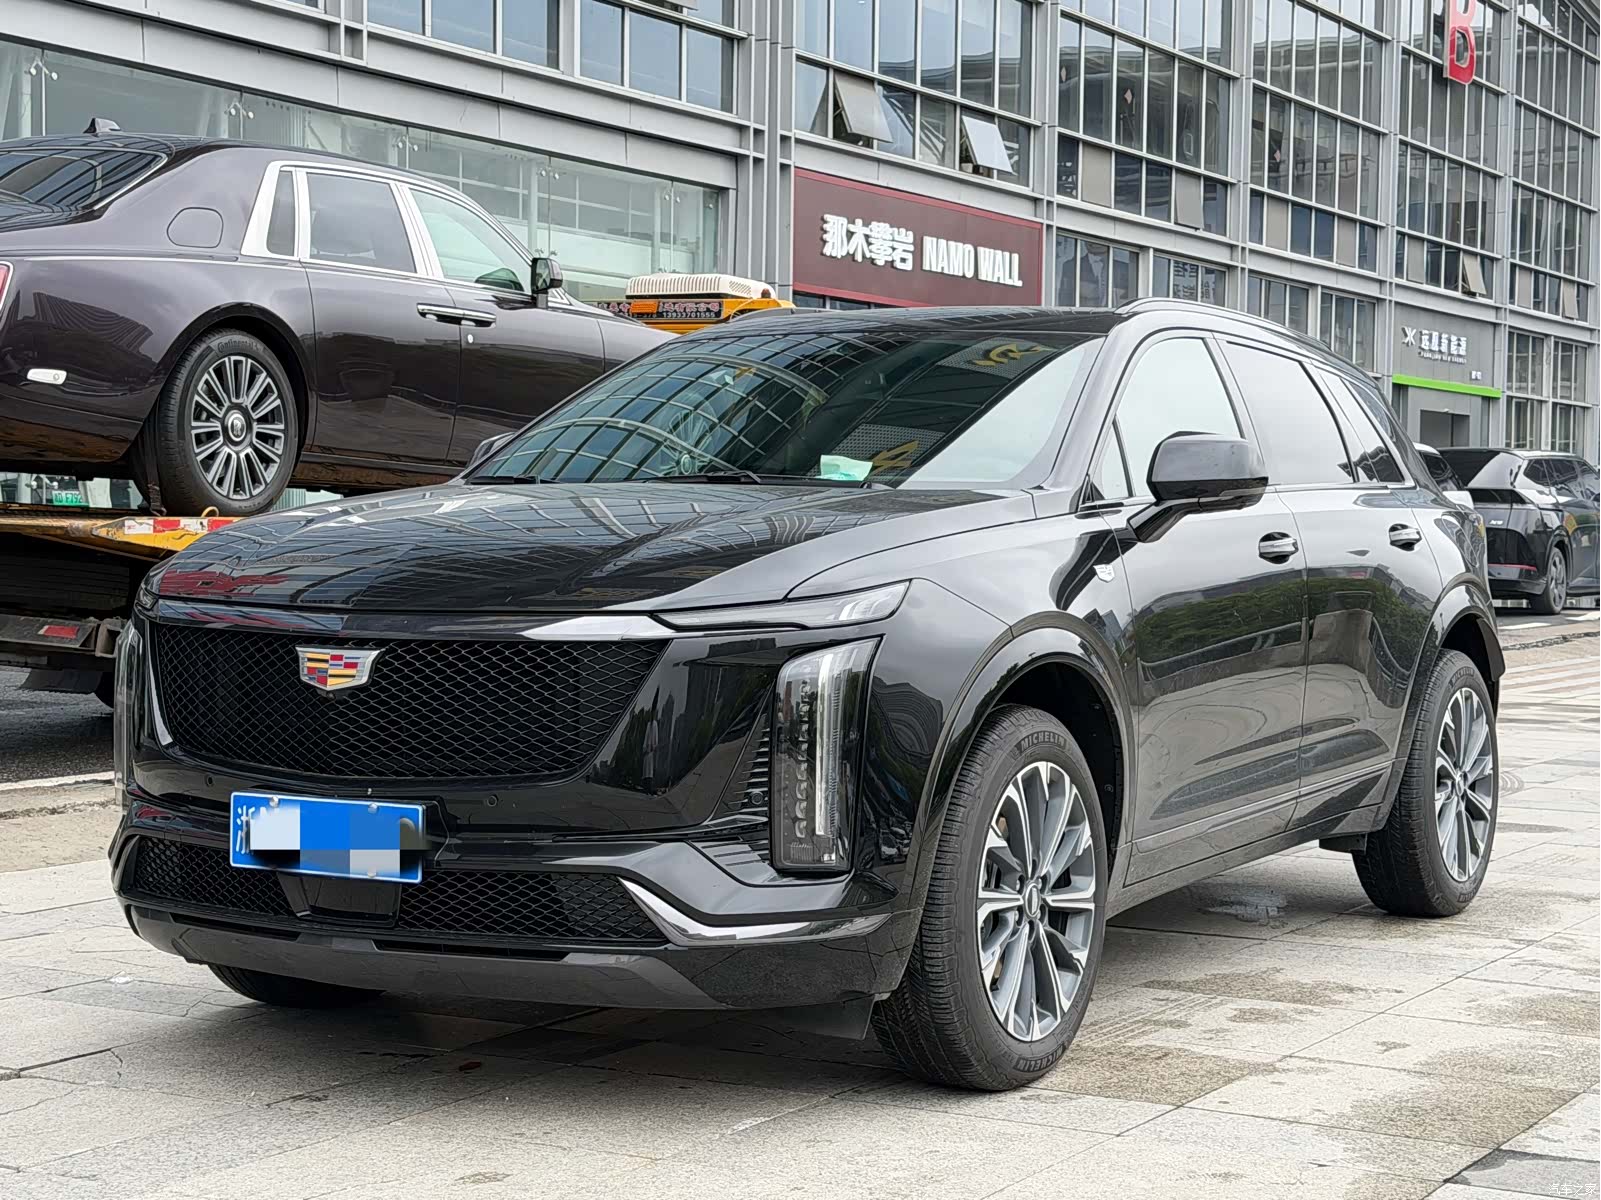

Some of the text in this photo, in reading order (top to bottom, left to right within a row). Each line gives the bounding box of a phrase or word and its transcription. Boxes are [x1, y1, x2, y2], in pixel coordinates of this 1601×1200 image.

[822, 213, 915, 271] 那木攀岩
[922, 235, 1023, 287] NAMO WALL
[1020, 730, 1066, 752] MICHELIN
[1016, 1044, 1065, 1072] MICHELIN
